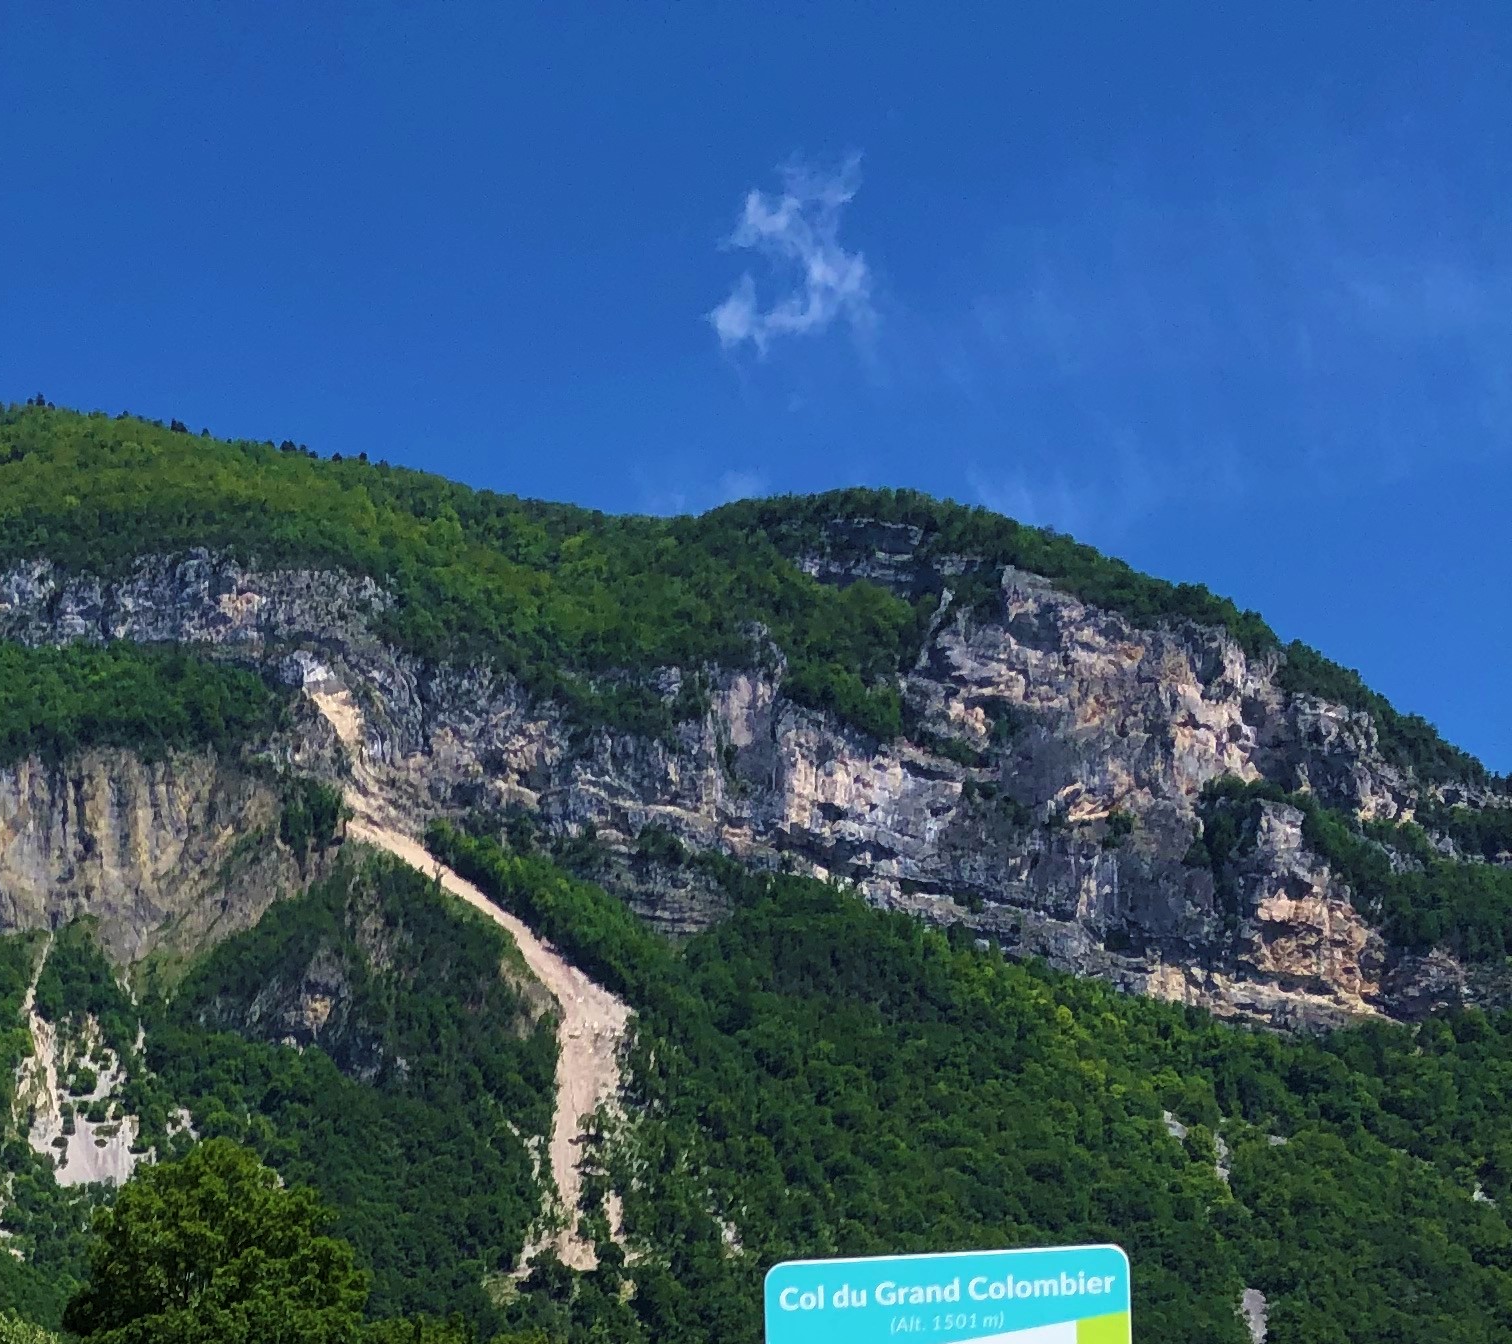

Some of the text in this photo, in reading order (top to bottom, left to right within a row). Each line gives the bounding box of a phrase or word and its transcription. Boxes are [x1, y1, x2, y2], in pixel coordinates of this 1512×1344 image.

[779, 1270, 1116, 1311] Col du Grand Colombier
[890, 1311, 1005, 1335] (Alt. 1501 m)
